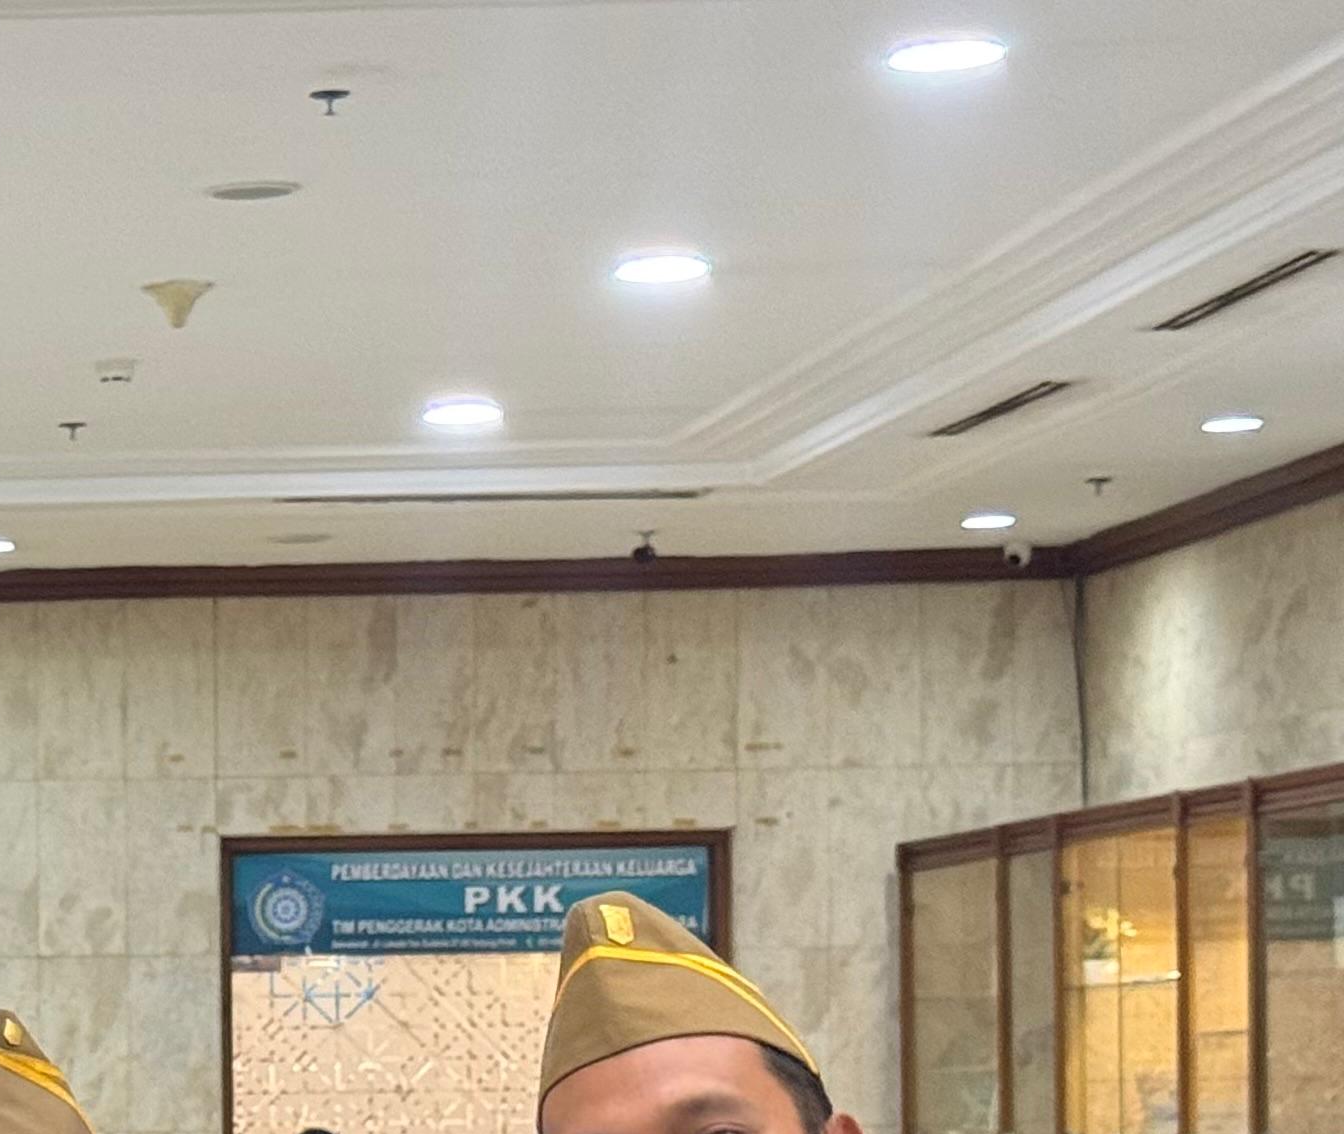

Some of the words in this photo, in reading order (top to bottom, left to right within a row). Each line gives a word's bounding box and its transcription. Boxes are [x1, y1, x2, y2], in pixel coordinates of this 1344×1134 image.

[331, 863, 449, 881] PEMBERDAYAAN
[451, 862, 483, 880] DAN
[486, 859, 612, 880] KESEJAHTERAAN
[616, 858, 697, 877] KELUARGA
[464, 884, 563, 914] PKK
[332, 920, 355, 934] TIM
[358, 919, 444, 935] PENGGERAK
[446, 918, 483, 933] KOTA
